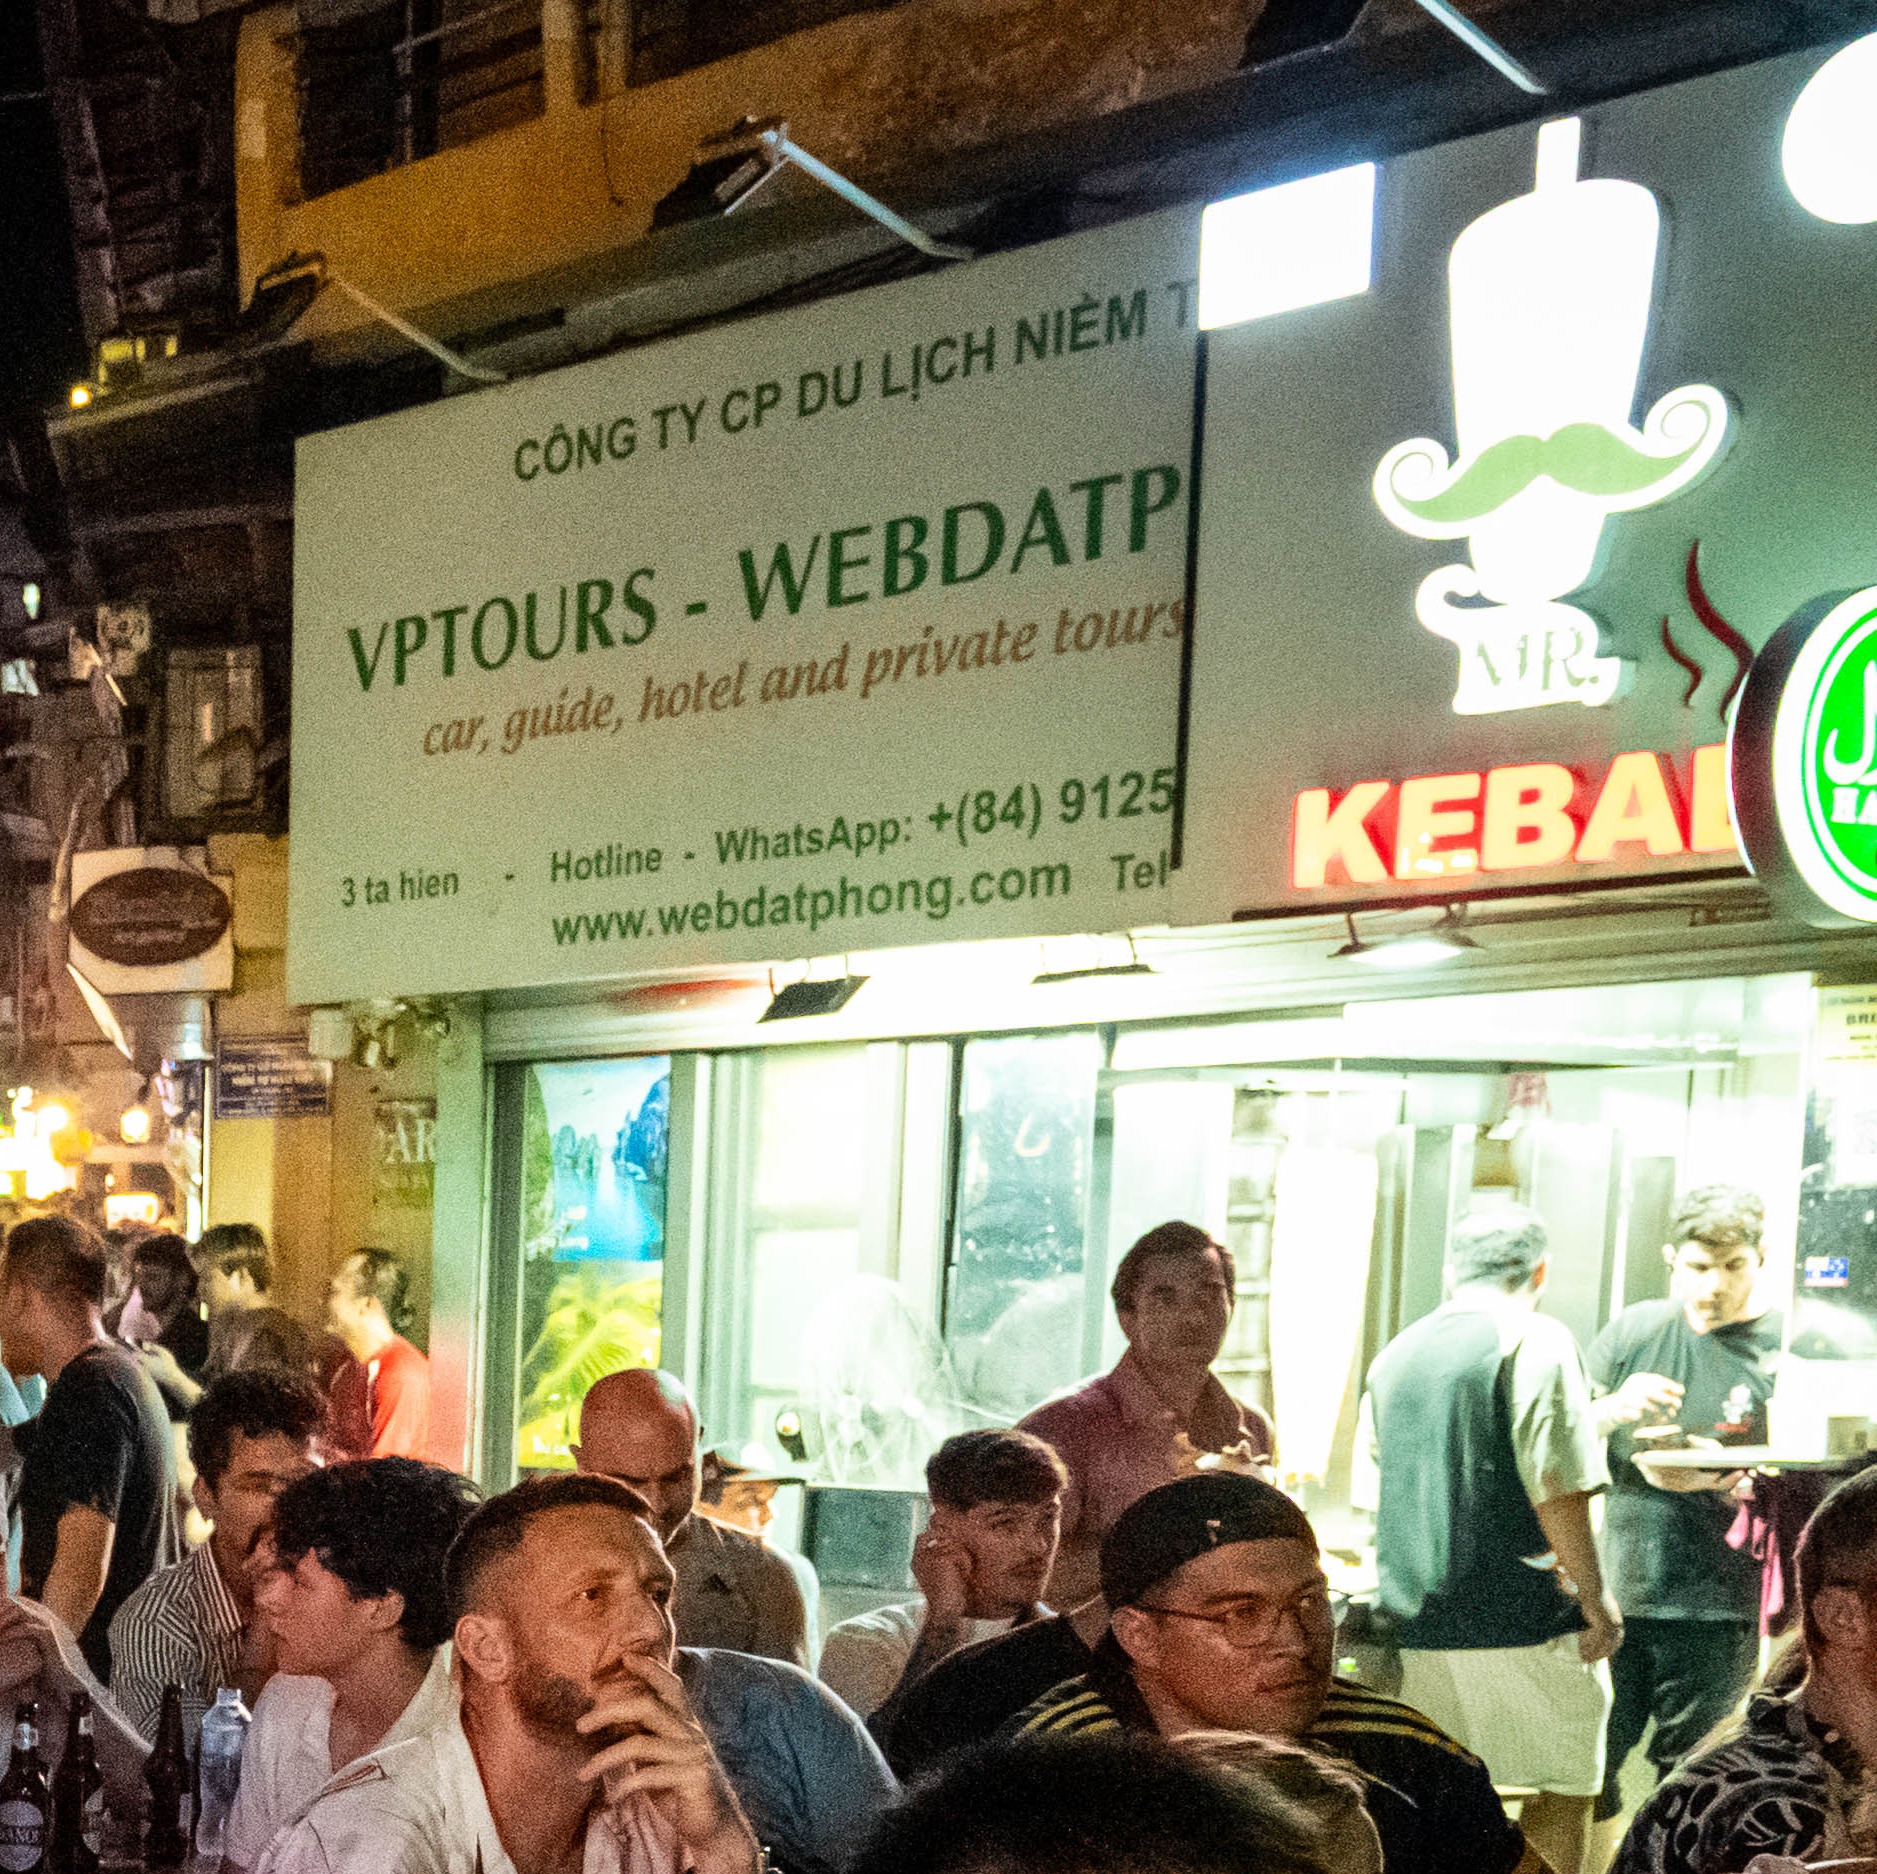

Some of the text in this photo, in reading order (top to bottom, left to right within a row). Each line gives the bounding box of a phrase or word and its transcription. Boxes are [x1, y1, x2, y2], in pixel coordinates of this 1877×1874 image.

[514, 415, 637, 482] CÔNG
[652, 398, 708, 450] TY
[720, 381, 783, 435] CP
[797, 360, 864, 419] DU
[881, 324, 997, 402] LỊCH
[347, 567, 658, 693] VPTOURS
[738, 464, 1181, 622] WEBDATP
[423, 598, 1195, 756] car, guide, hotel and private tours
[341, 876, 357, 908] 3
[364, 875, 390, 905] ta
[398, 867, 460, 902] hien
[550, 843, 664, 884] Hotline
[715, 815, 913, 865] WhatsApp:
[928, 782, 1042, 848] +(84)
[1059, 766, 1176, 824] 9125
[553, 861, 1071, 946] www.webdatphong.com
